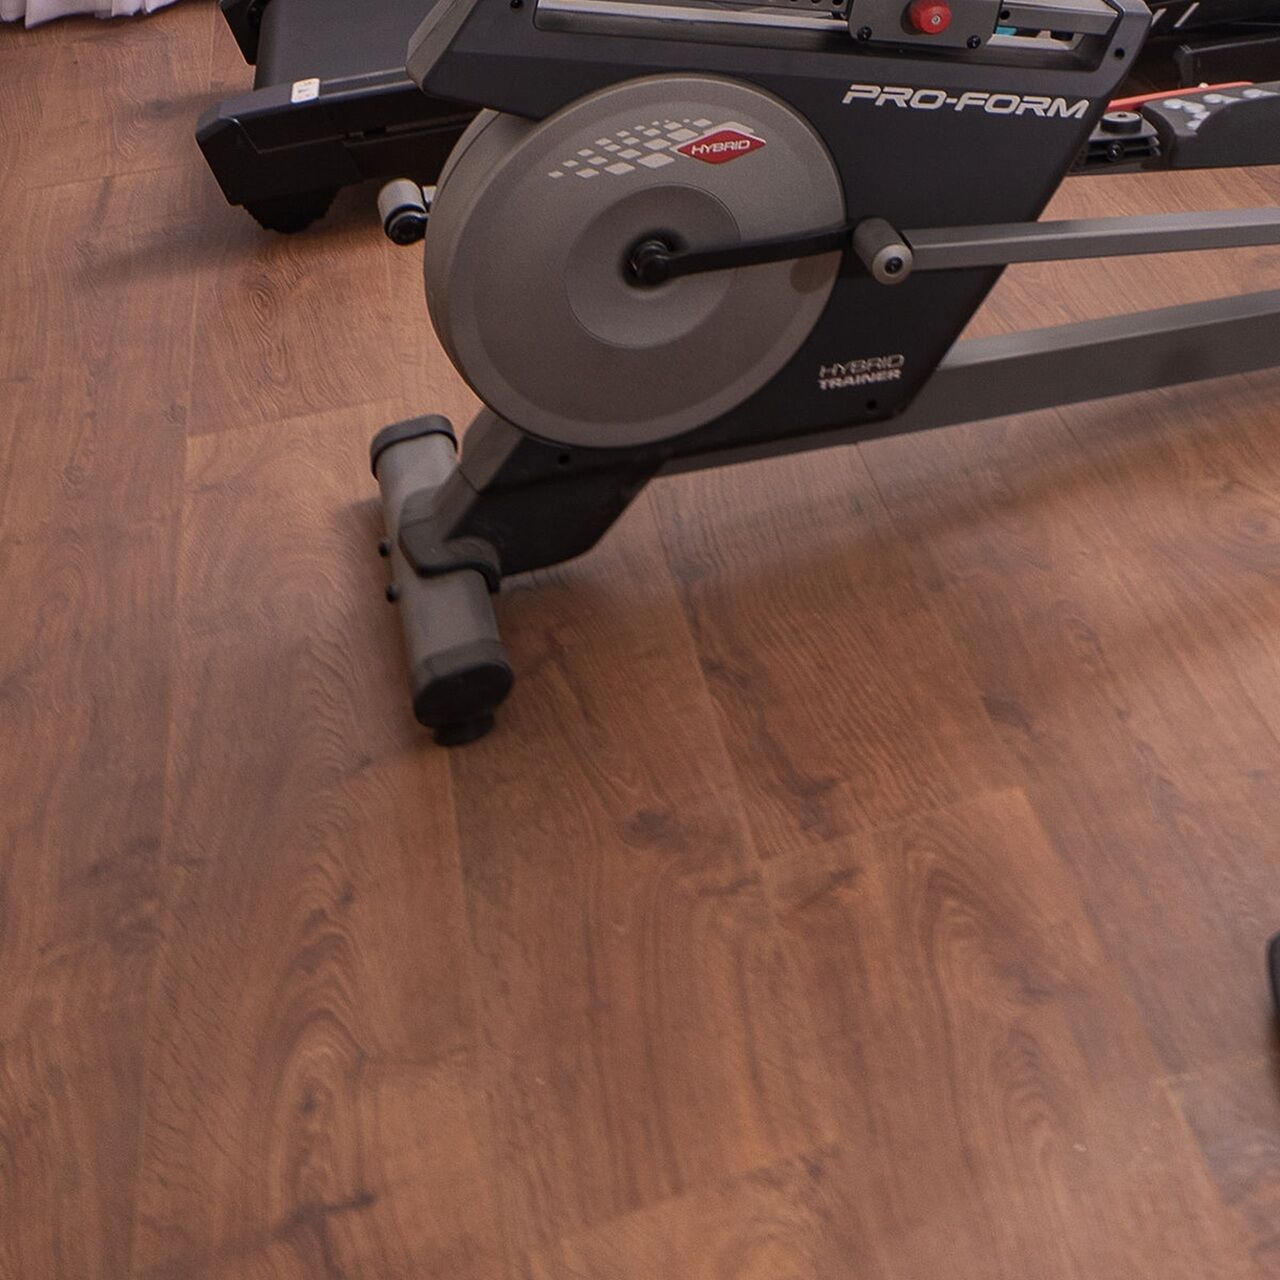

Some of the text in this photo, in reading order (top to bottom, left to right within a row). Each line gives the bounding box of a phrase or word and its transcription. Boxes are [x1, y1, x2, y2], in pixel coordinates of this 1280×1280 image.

[841, 83, 1091, 120] PRO-FORM
[690, 139, 751, 156] HYBRID
[819, 353, 905, 379] HYBRID
